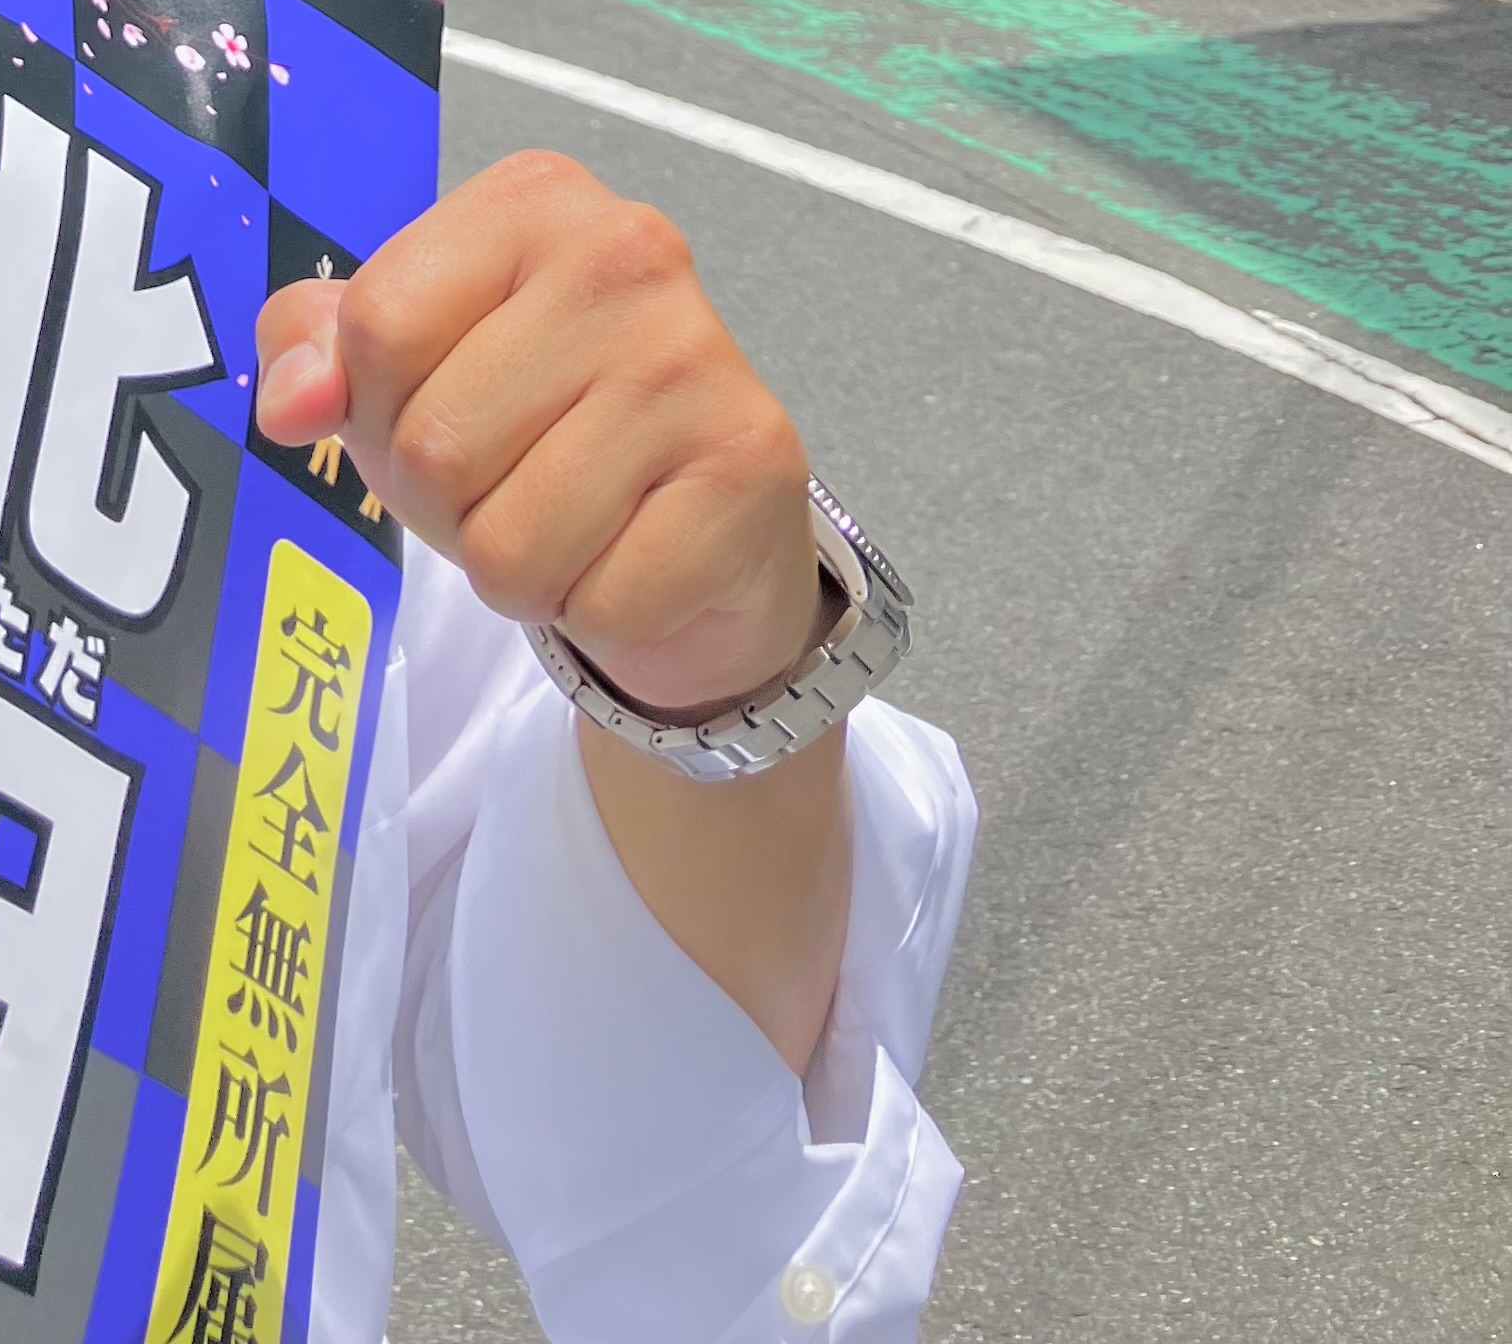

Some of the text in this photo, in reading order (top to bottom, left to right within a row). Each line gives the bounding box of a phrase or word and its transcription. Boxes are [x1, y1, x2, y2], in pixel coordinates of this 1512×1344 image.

[165, 606, 351, 1344] 完全無所属
